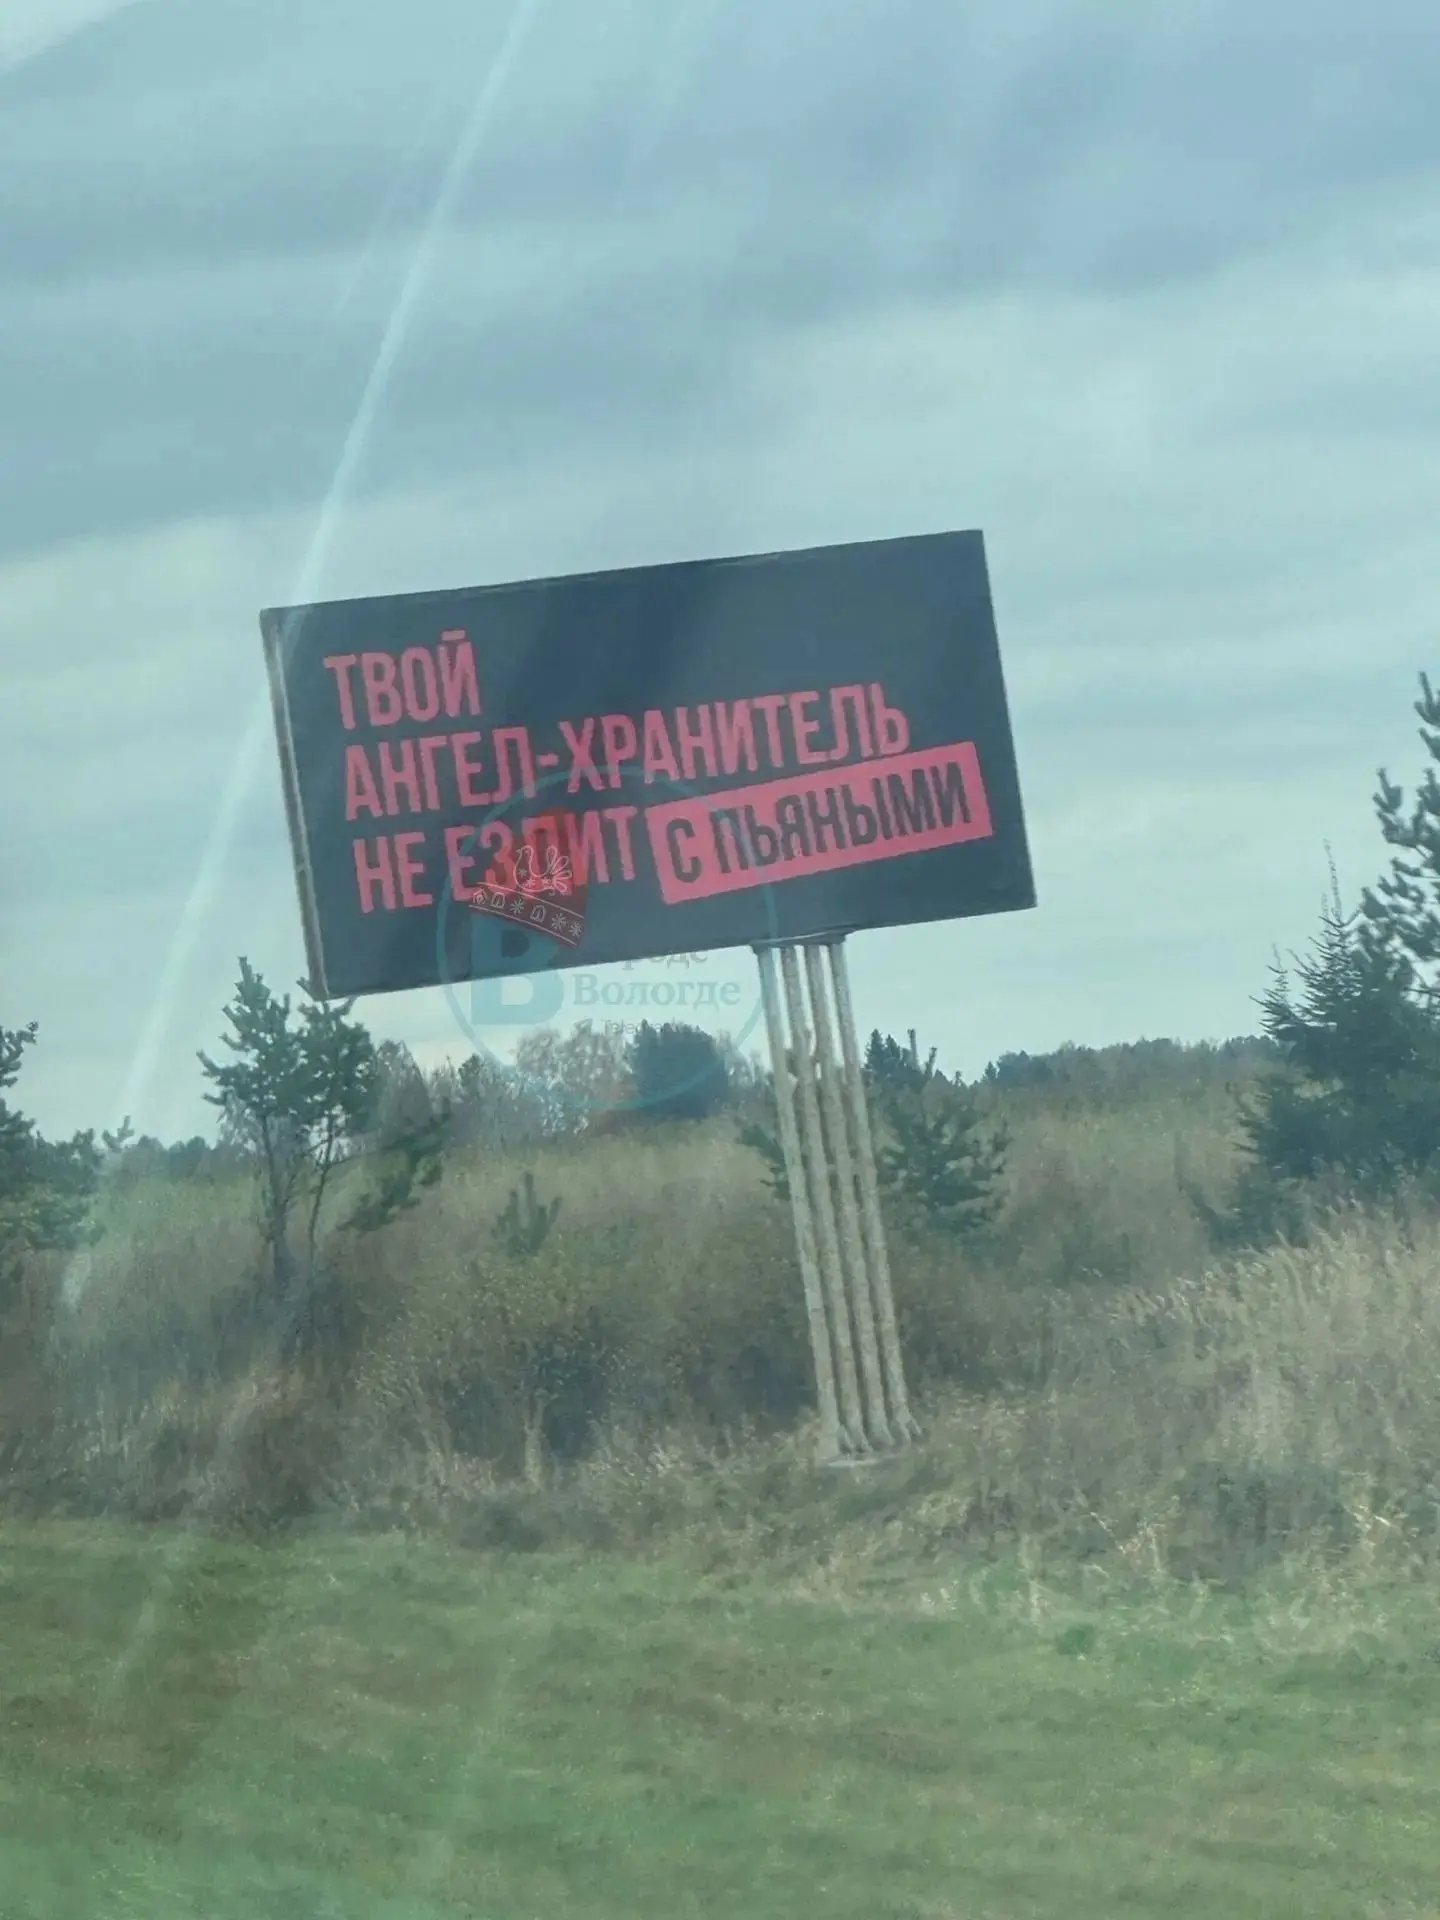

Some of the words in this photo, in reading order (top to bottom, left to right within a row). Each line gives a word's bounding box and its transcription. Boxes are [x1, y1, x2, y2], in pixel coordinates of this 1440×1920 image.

[323, 629, 482, 729] ТВОЙ
[345, 681, 910, 820] АНГЕЛ-ХРАНИТЕЛЬ
[353, 832, 433, 913] НЕ
[444, 805, 637, 902] ЕЗДИТ
[666, 818, 703, 883] С
[709, 761, 972, 874] ПЬЯНЫМИ
